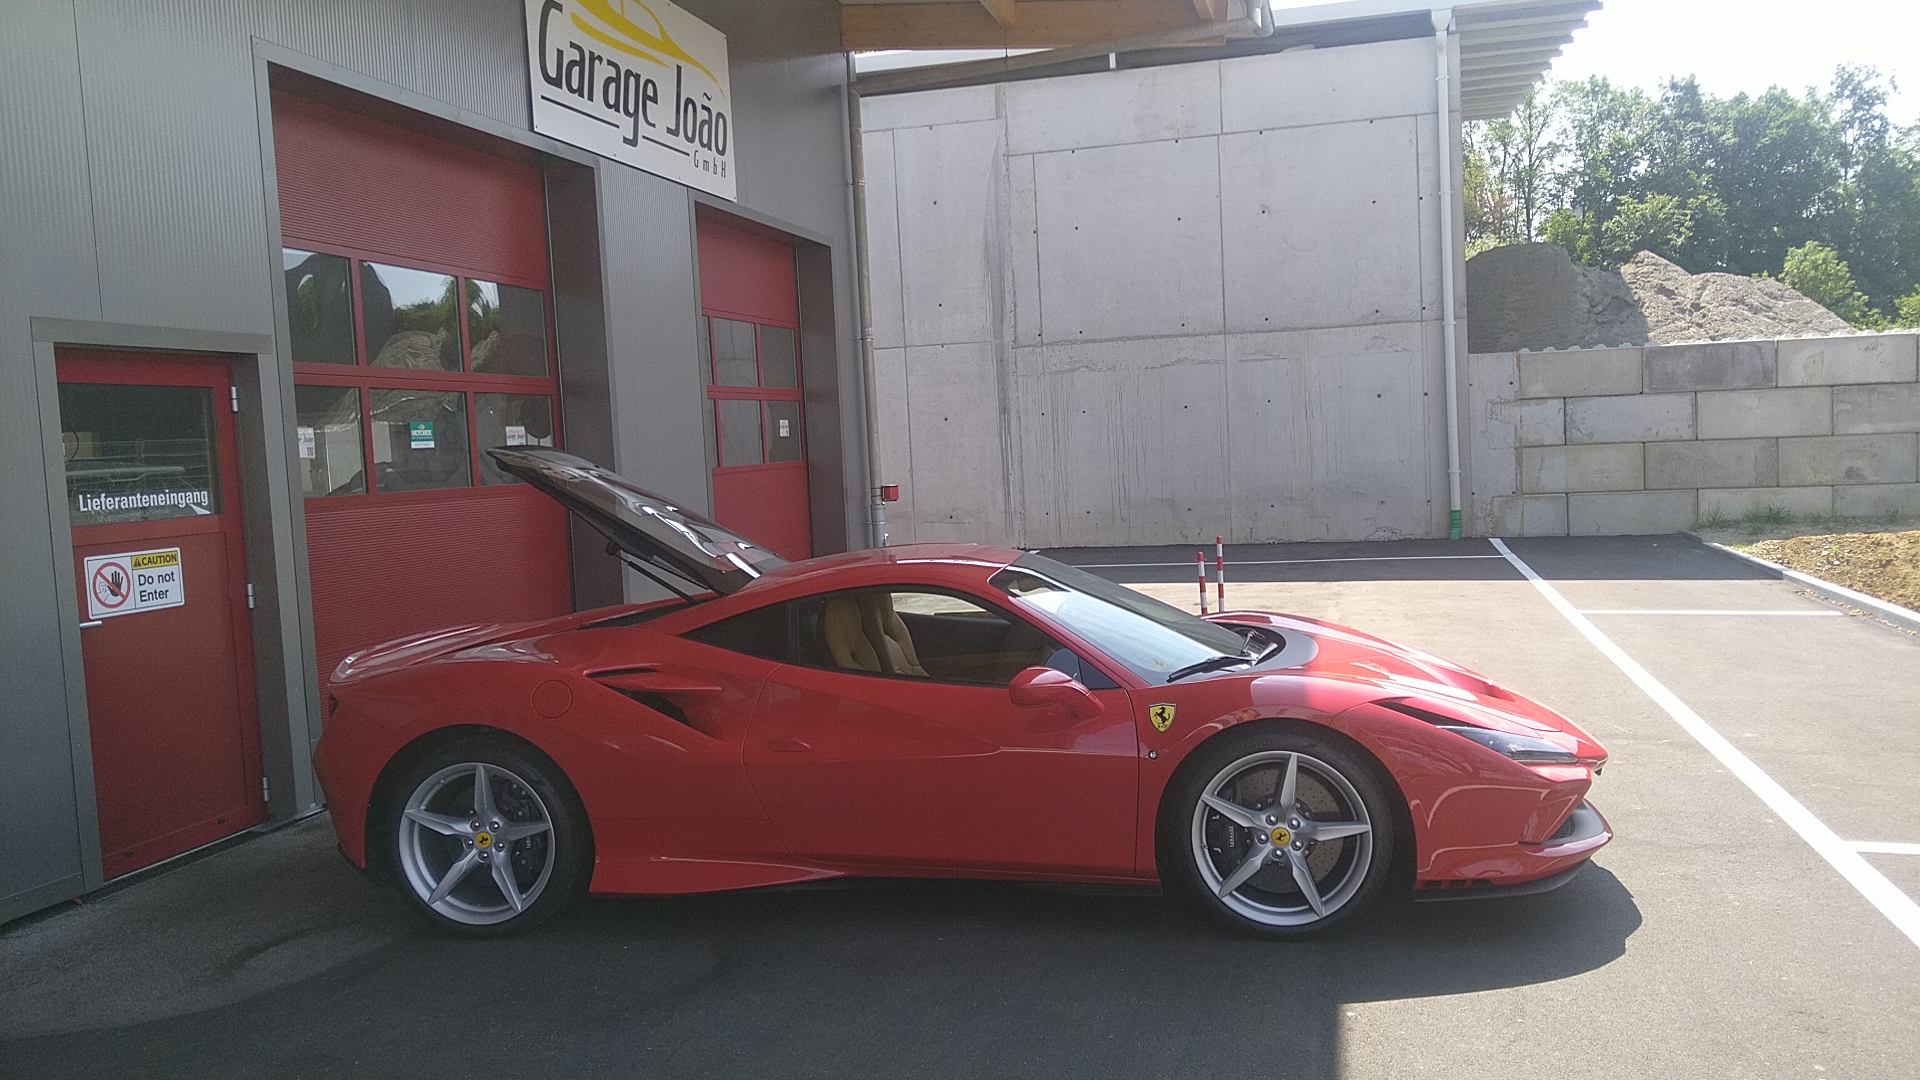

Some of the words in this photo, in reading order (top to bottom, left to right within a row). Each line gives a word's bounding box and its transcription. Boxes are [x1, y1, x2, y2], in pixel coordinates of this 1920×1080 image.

[538, 0, 659, 148] Garage
[667, 64, 727, 157] João
[693, 150, 727, 178] GmbH
[78, 490, 208, 512] Lieferanteneingang
[142, 554, 177, 566] CAUTION
[138, 574, 154, 586] Do
[157, 571, 175, 584] not
[139, 589, 169, 603] Enter
